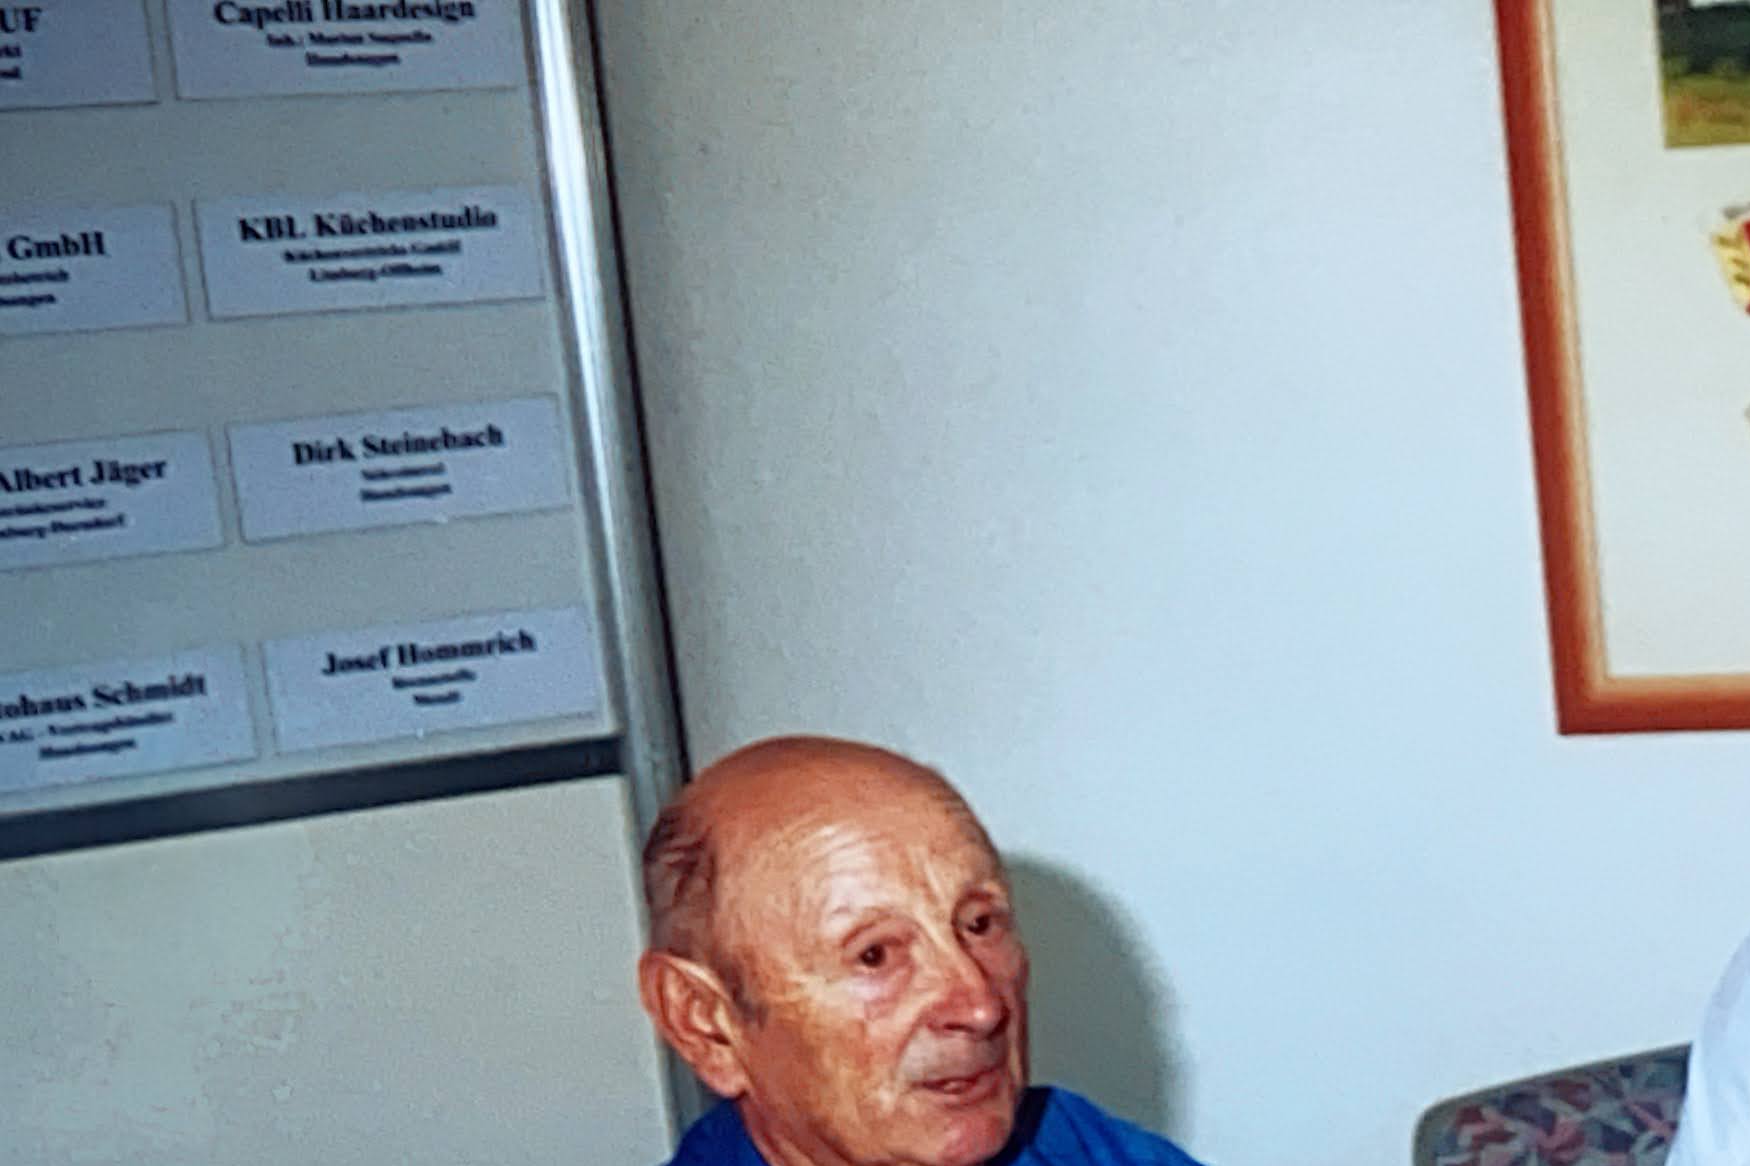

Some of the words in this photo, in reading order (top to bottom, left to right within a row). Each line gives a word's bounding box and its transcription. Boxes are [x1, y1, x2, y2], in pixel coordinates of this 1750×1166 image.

[214, 0, 312, 29] Capelli
[238, 214, 306, 241] KBL
[314, 200, 498, 237] Küchenstudio
[7, 231, 105, 260] GmbH
[293, 435, 356, 465] Dirk
[361, 422, 504, 458] Steinebach
[90, 460, 166, 488] Jäger
[321, 645, 391, 676] Josef
[92, 672, 206, 709] Schmidt
